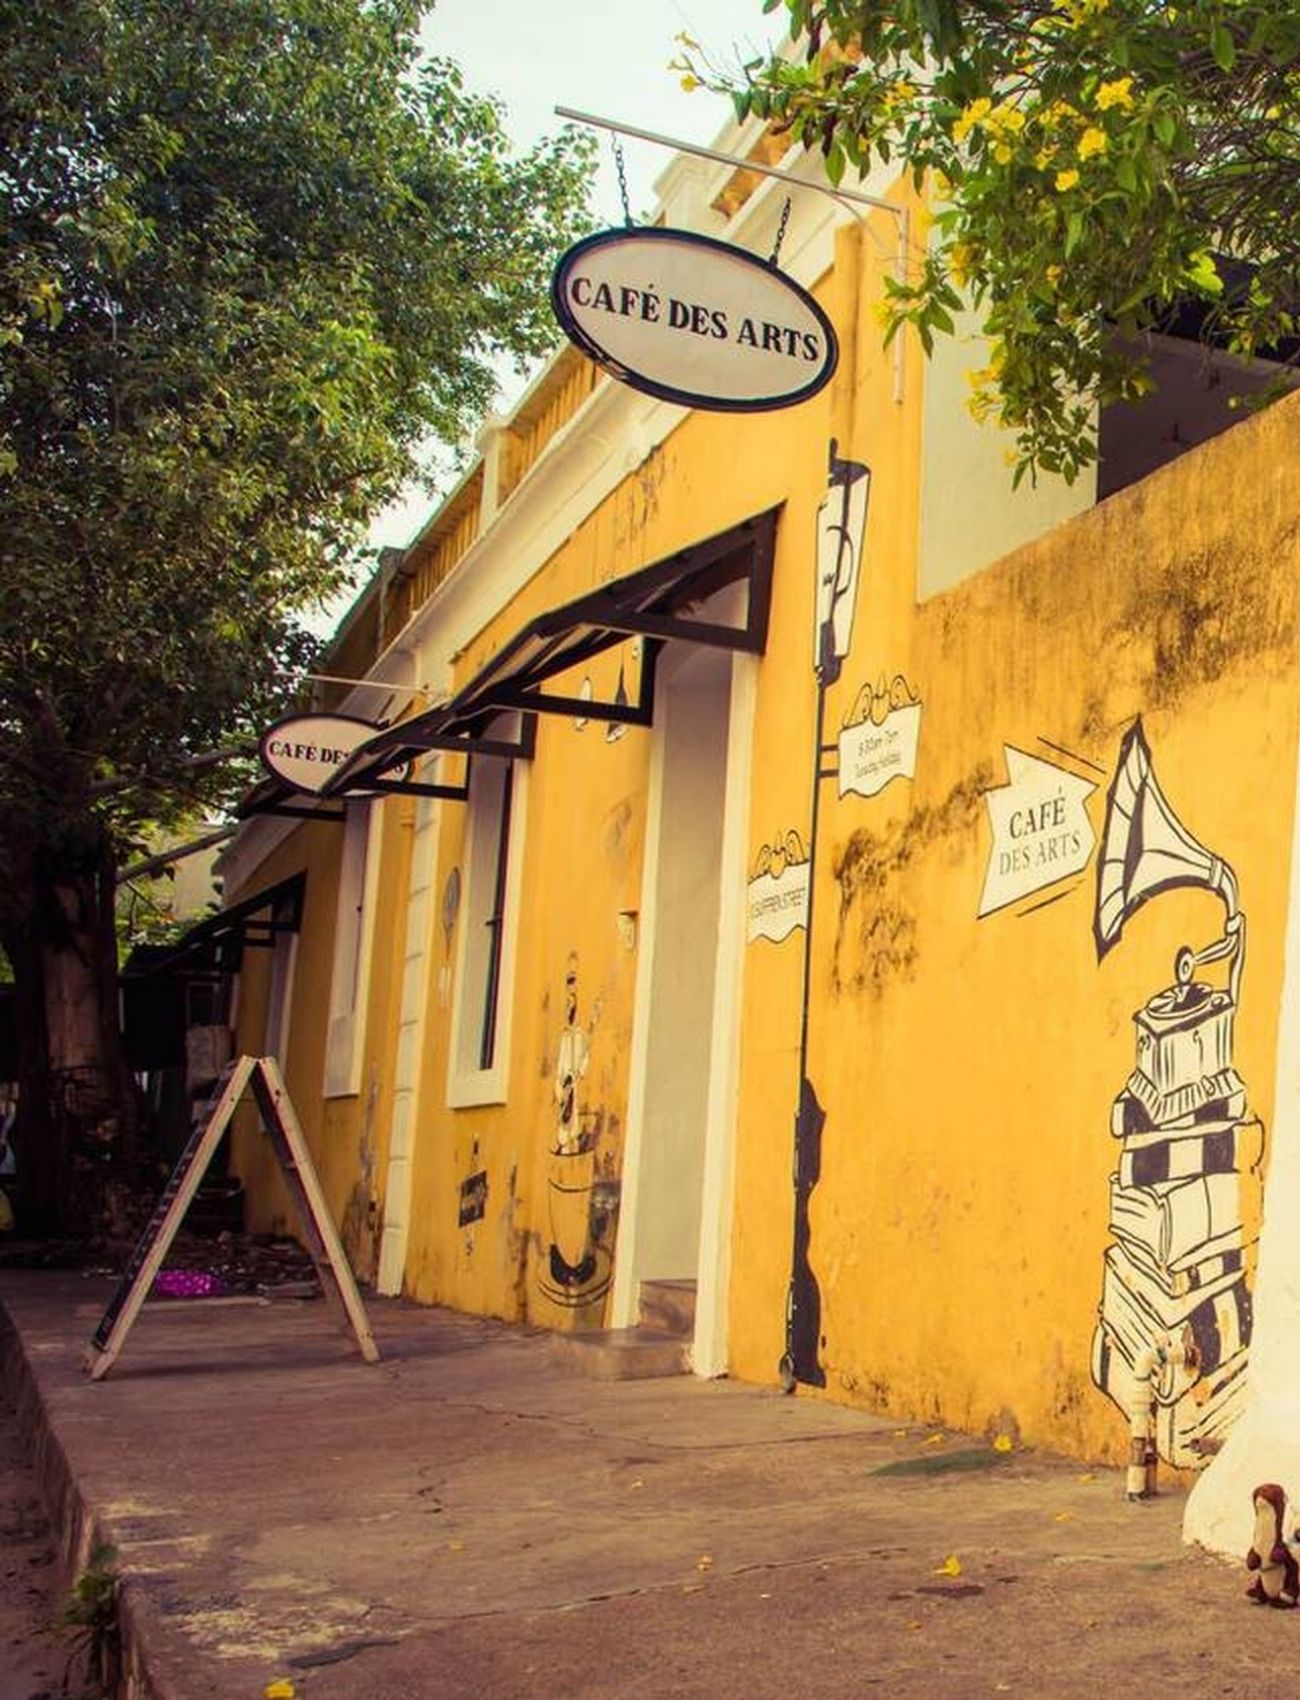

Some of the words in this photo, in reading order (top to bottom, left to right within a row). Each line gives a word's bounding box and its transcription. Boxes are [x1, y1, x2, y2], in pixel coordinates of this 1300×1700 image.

[571, 277, 661, 323] CAFÉ
[668, 299, 728, 340] DES
[736, 318, 820, 362] ARTS
[269, 740, 317, 761] CAFÉ
[1009, 786, 1067, 839] CAFÉ
[999, 844, 1030, 875] DES
[1035, 830, 1081, 867] ARTS
